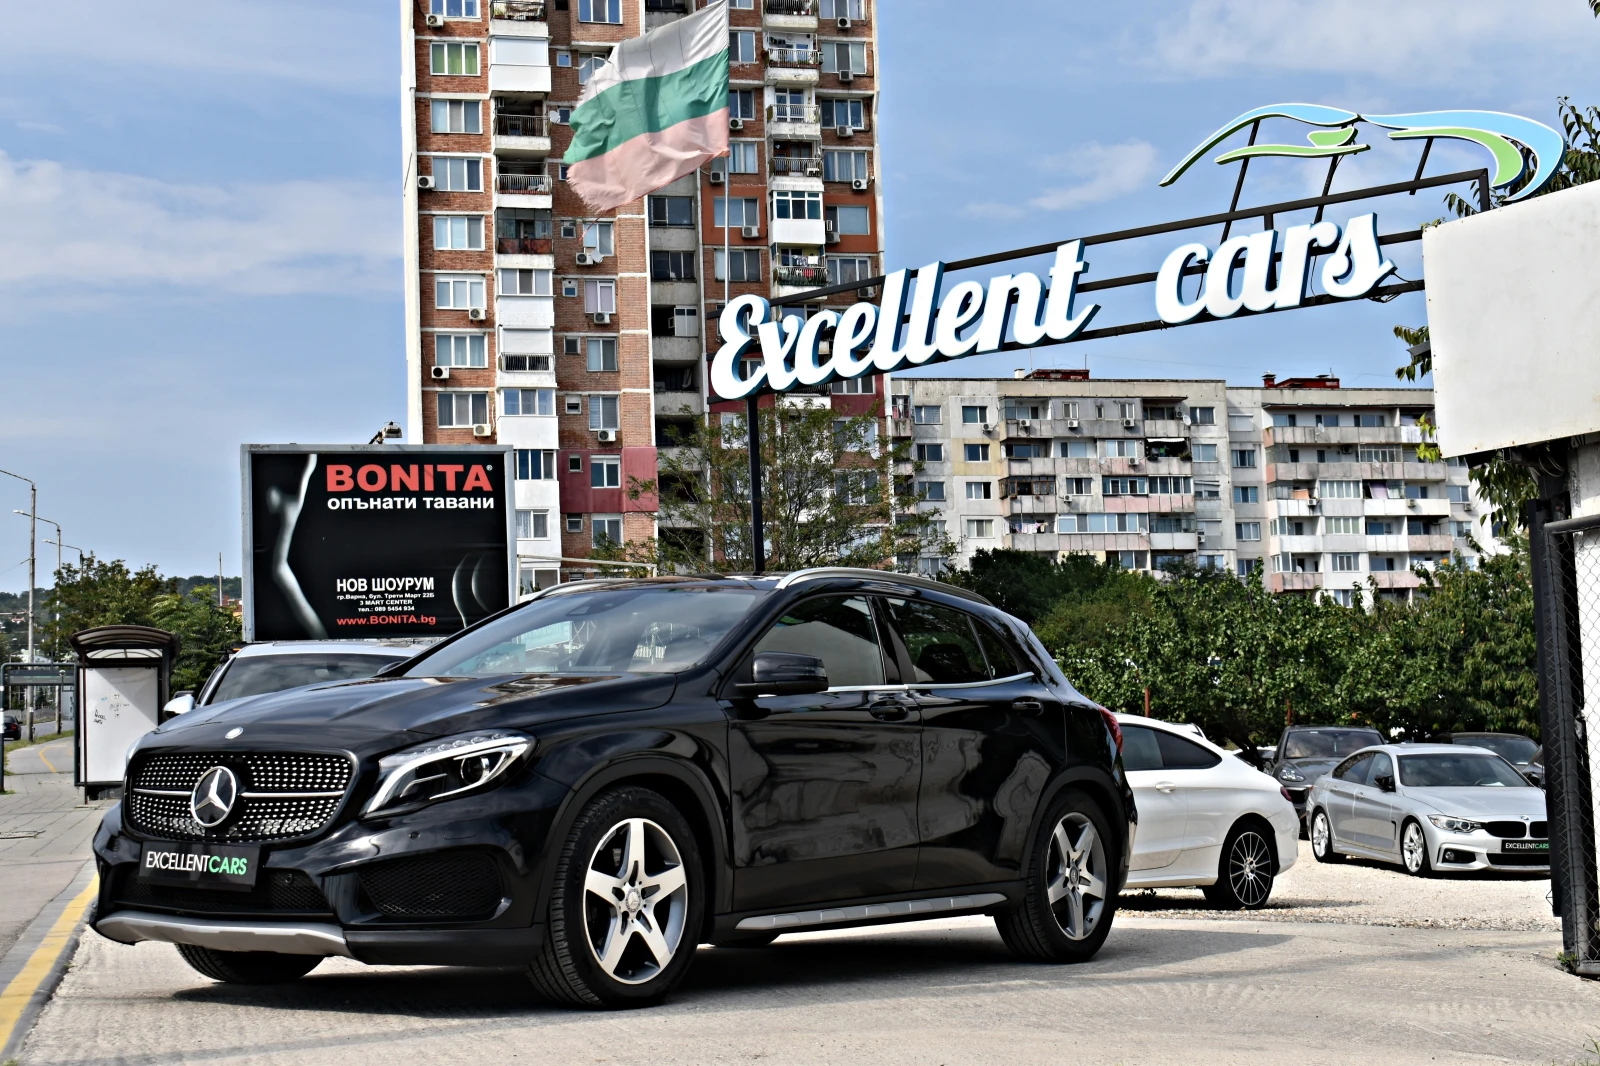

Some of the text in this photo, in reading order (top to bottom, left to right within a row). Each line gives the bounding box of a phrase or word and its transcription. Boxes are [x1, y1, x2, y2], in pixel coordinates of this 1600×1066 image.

[710, 211, 1397, 400] Excellent cars
[327, 497, 495, 510] опънати тавани
[336, 577, 435, 592] НОВ ШОУРУМ
[336, 614, 436, 626] www.BONITA.bg
